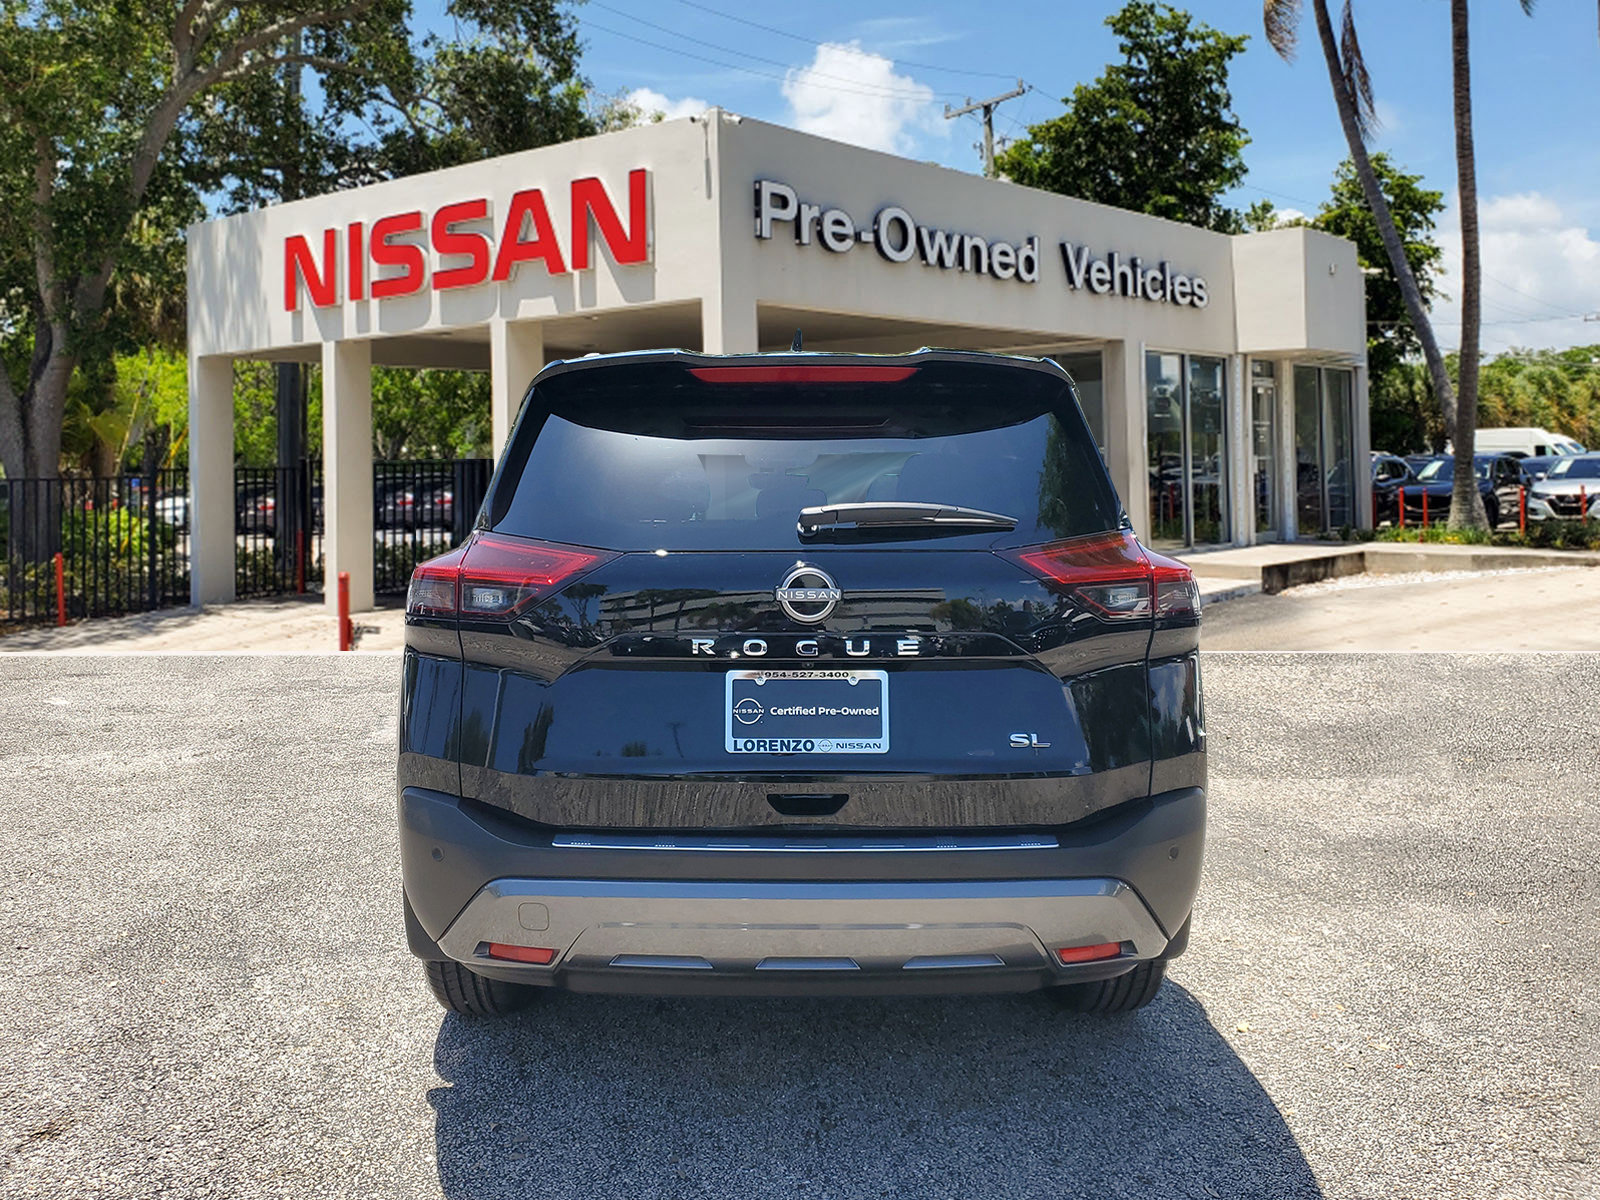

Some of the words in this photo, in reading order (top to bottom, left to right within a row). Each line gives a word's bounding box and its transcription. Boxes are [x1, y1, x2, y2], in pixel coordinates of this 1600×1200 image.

[284, 168, 651, 312] NISSAN
[754, 179, 1040, 284] Pre-Owned
[1061, 241, 1209, 309] Vehicles
[777, 589, 841, 600] NISSAN
[691, 638, 921, 657] ROGUE
[764, 671, 849, 679] 954-527-3400
[769, 706, 816, 716] Certified
[818, 706, 880, 716] Pre-Owned
[733, 739, 815, 752] LORENZO
[836, 742, 882, 750] NISSAN
[1009, 733, 1052, 748] SL
